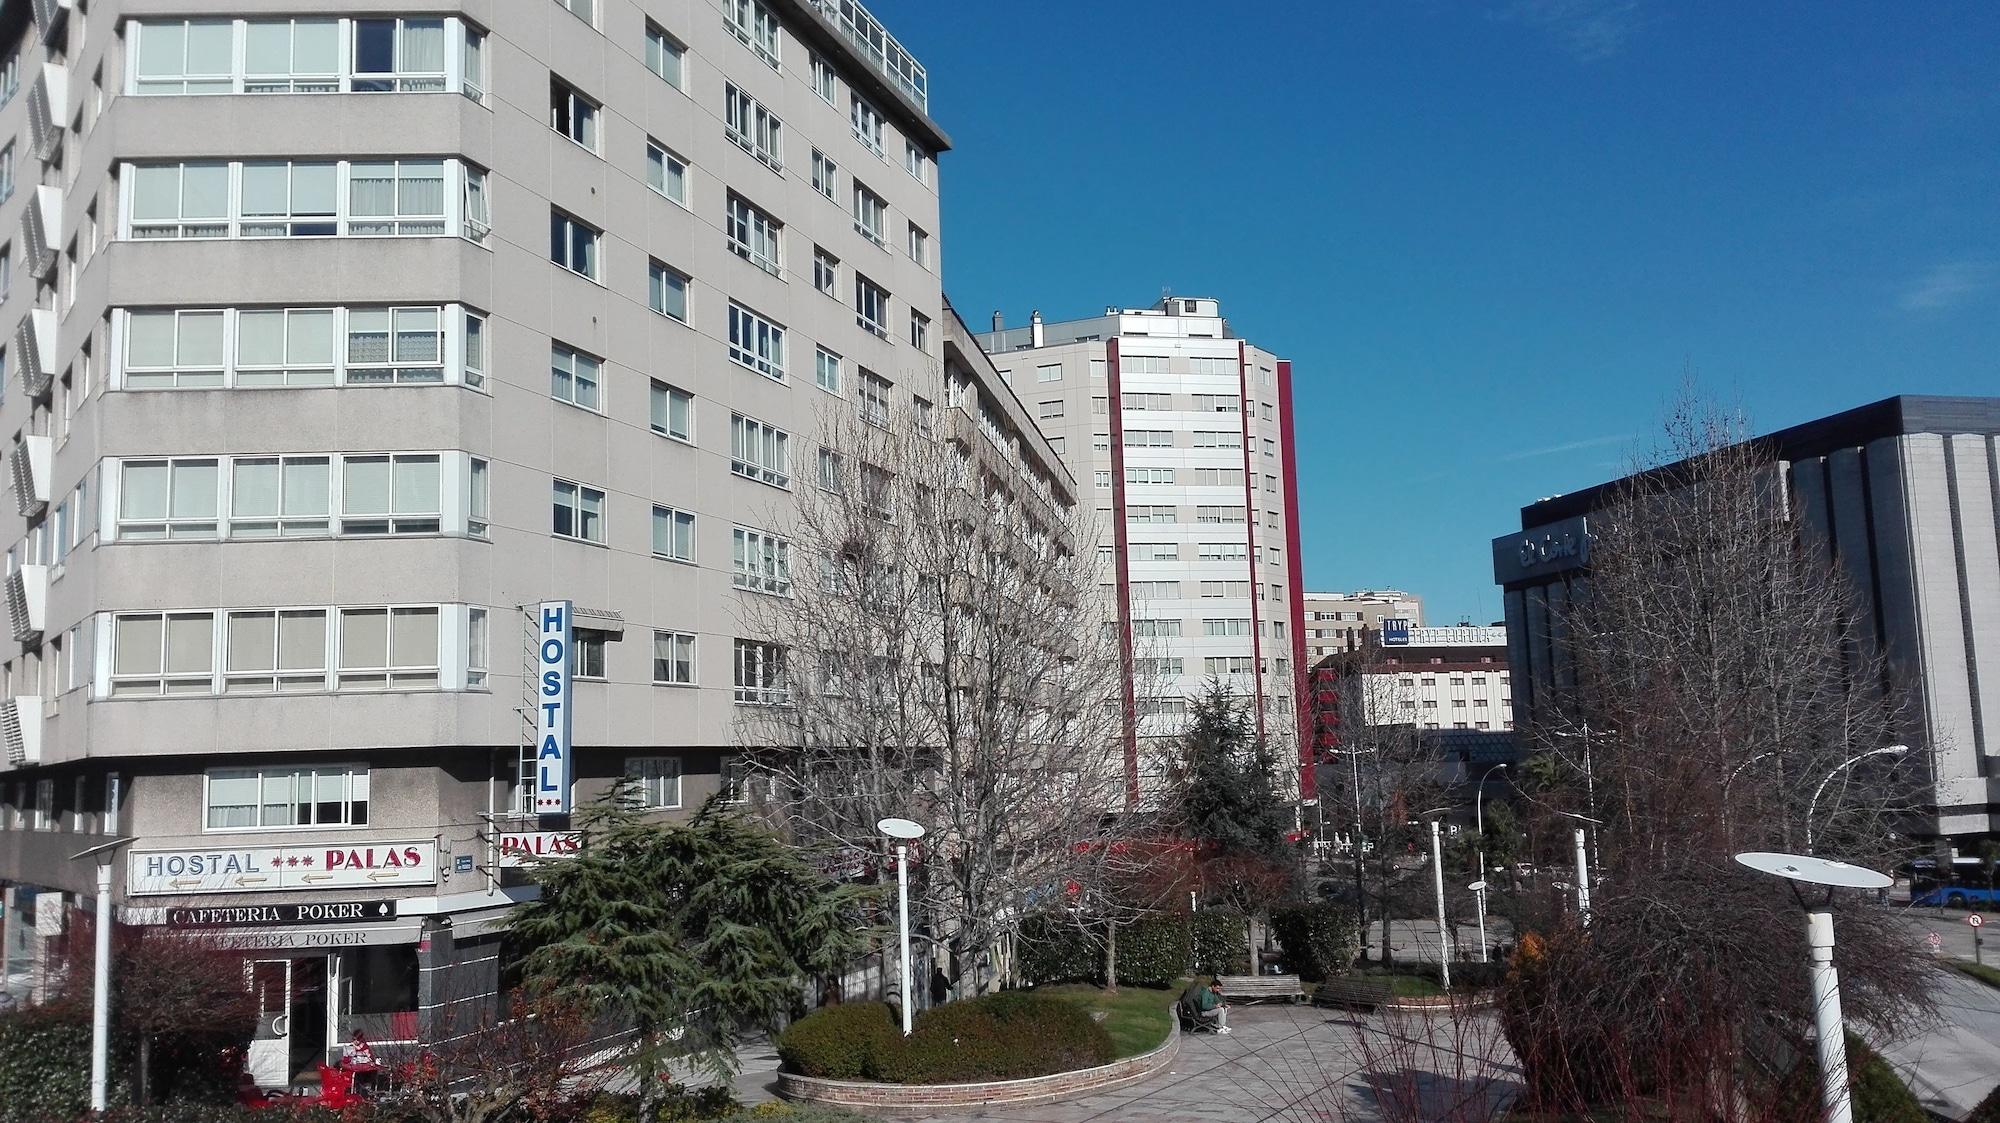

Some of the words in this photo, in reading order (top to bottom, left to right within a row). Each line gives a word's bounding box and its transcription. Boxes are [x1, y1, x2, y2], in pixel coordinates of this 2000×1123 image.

[1387, 620, 1408, 631] TRYP
[539, 607, 563, 792] HOSTAL
[502, 835, 578, 856] PALAS
[146, 854, 260, 877] HOSTAL
[326, 846, 421, 871] PALAS
[173, 905, 281, 925] CAFETERIA
[296, 903, 364, 921] POKER
[306, 932, 367, 946] POKER
